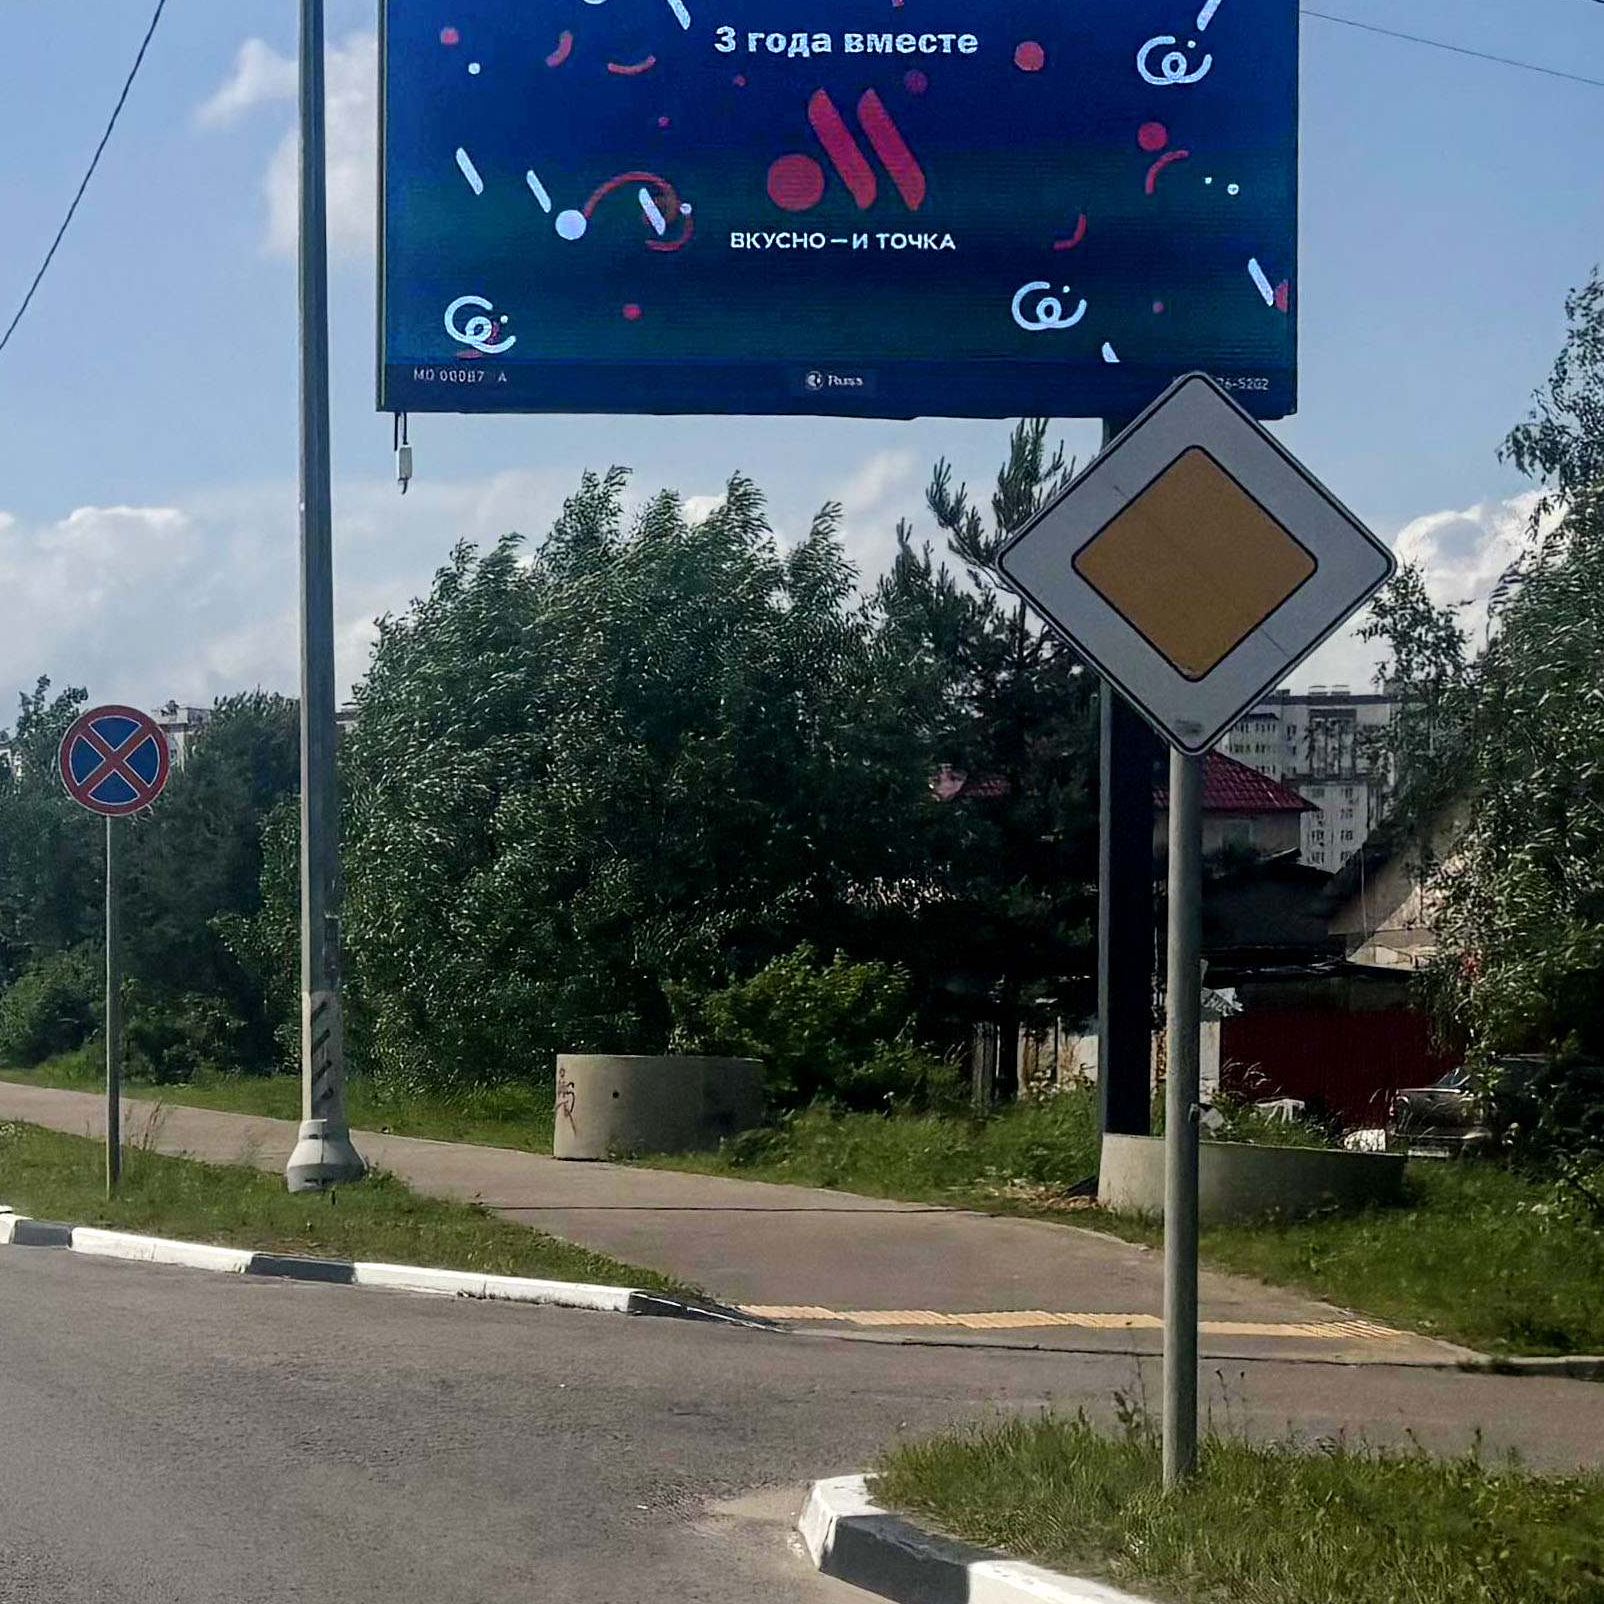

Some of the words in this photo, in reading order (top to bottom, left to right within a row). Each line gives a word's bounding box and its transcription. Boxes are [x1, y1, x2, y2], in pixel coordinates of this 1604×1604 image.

[714, 25, 736, 54] 3
[747, 31, 832, 58] года
[844, 32, 979, 54] вместе
[730, 232, 826, 249] ВКУСНО
[852, 232, 869, 249] И
[875, 233, 956, 250] ТОЧКА
